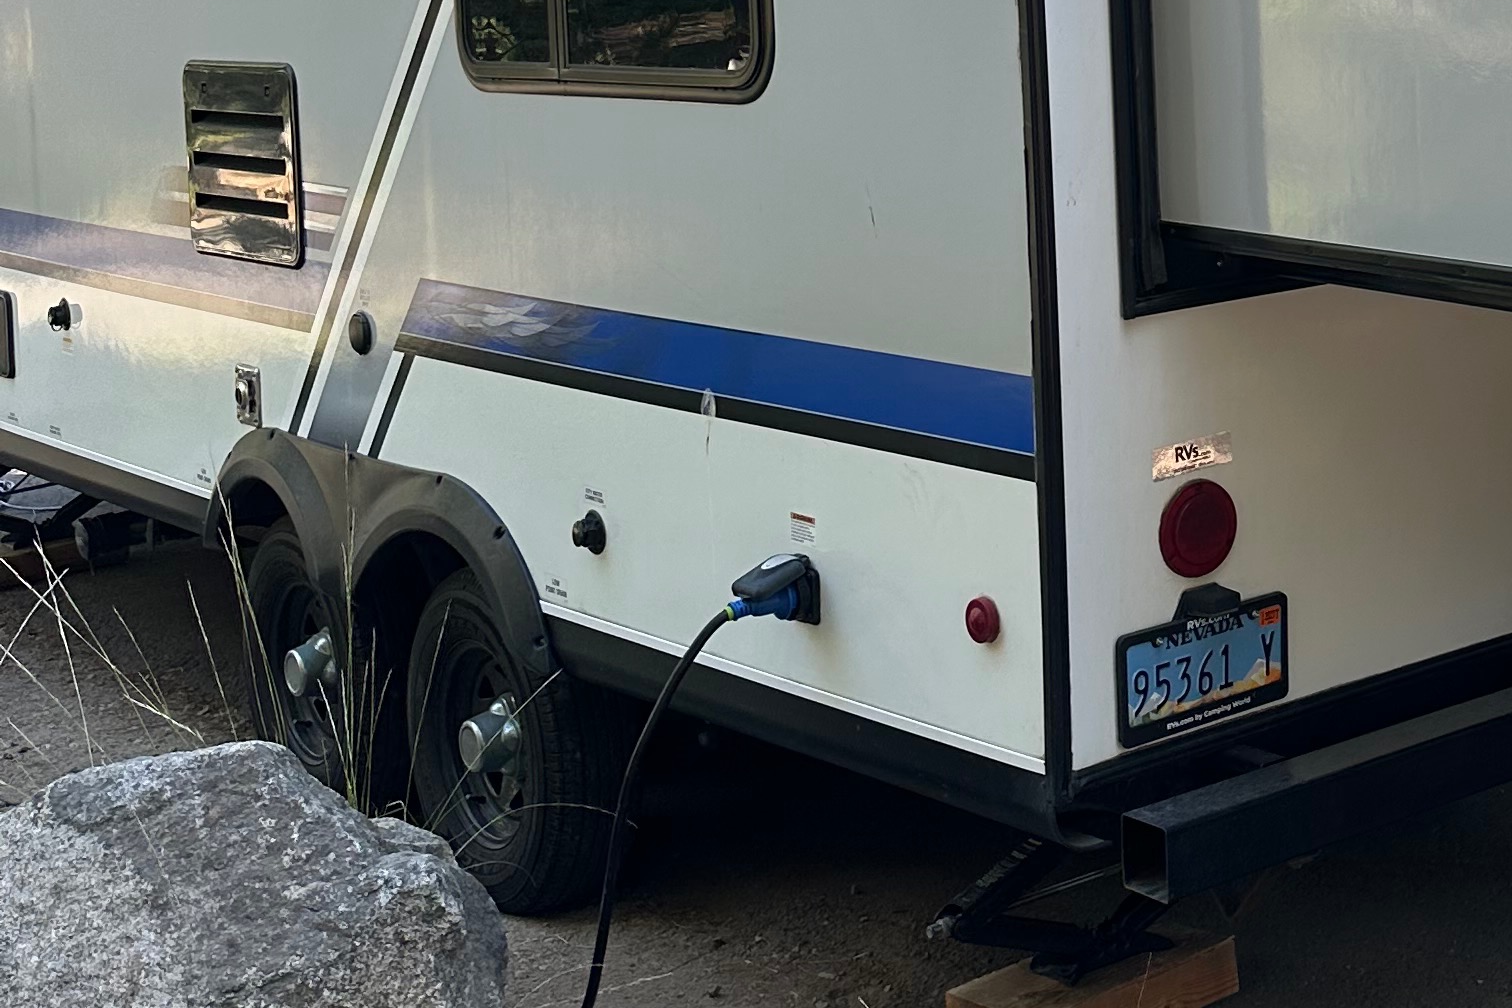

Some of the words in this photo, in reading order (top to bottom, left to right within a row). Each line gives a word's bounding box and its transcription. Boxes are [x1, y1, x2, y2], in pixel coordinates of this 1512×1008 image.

[1165, 614, 1245, 649] NEVADA
[1134, 643, 1235, 718] 95361
[1260, 630, 1275, 677] Y
[1194, 713, 1204, 722] by
[1203, 703, 1232, 718] Camping
[1232, 696, 1252, 709] World
